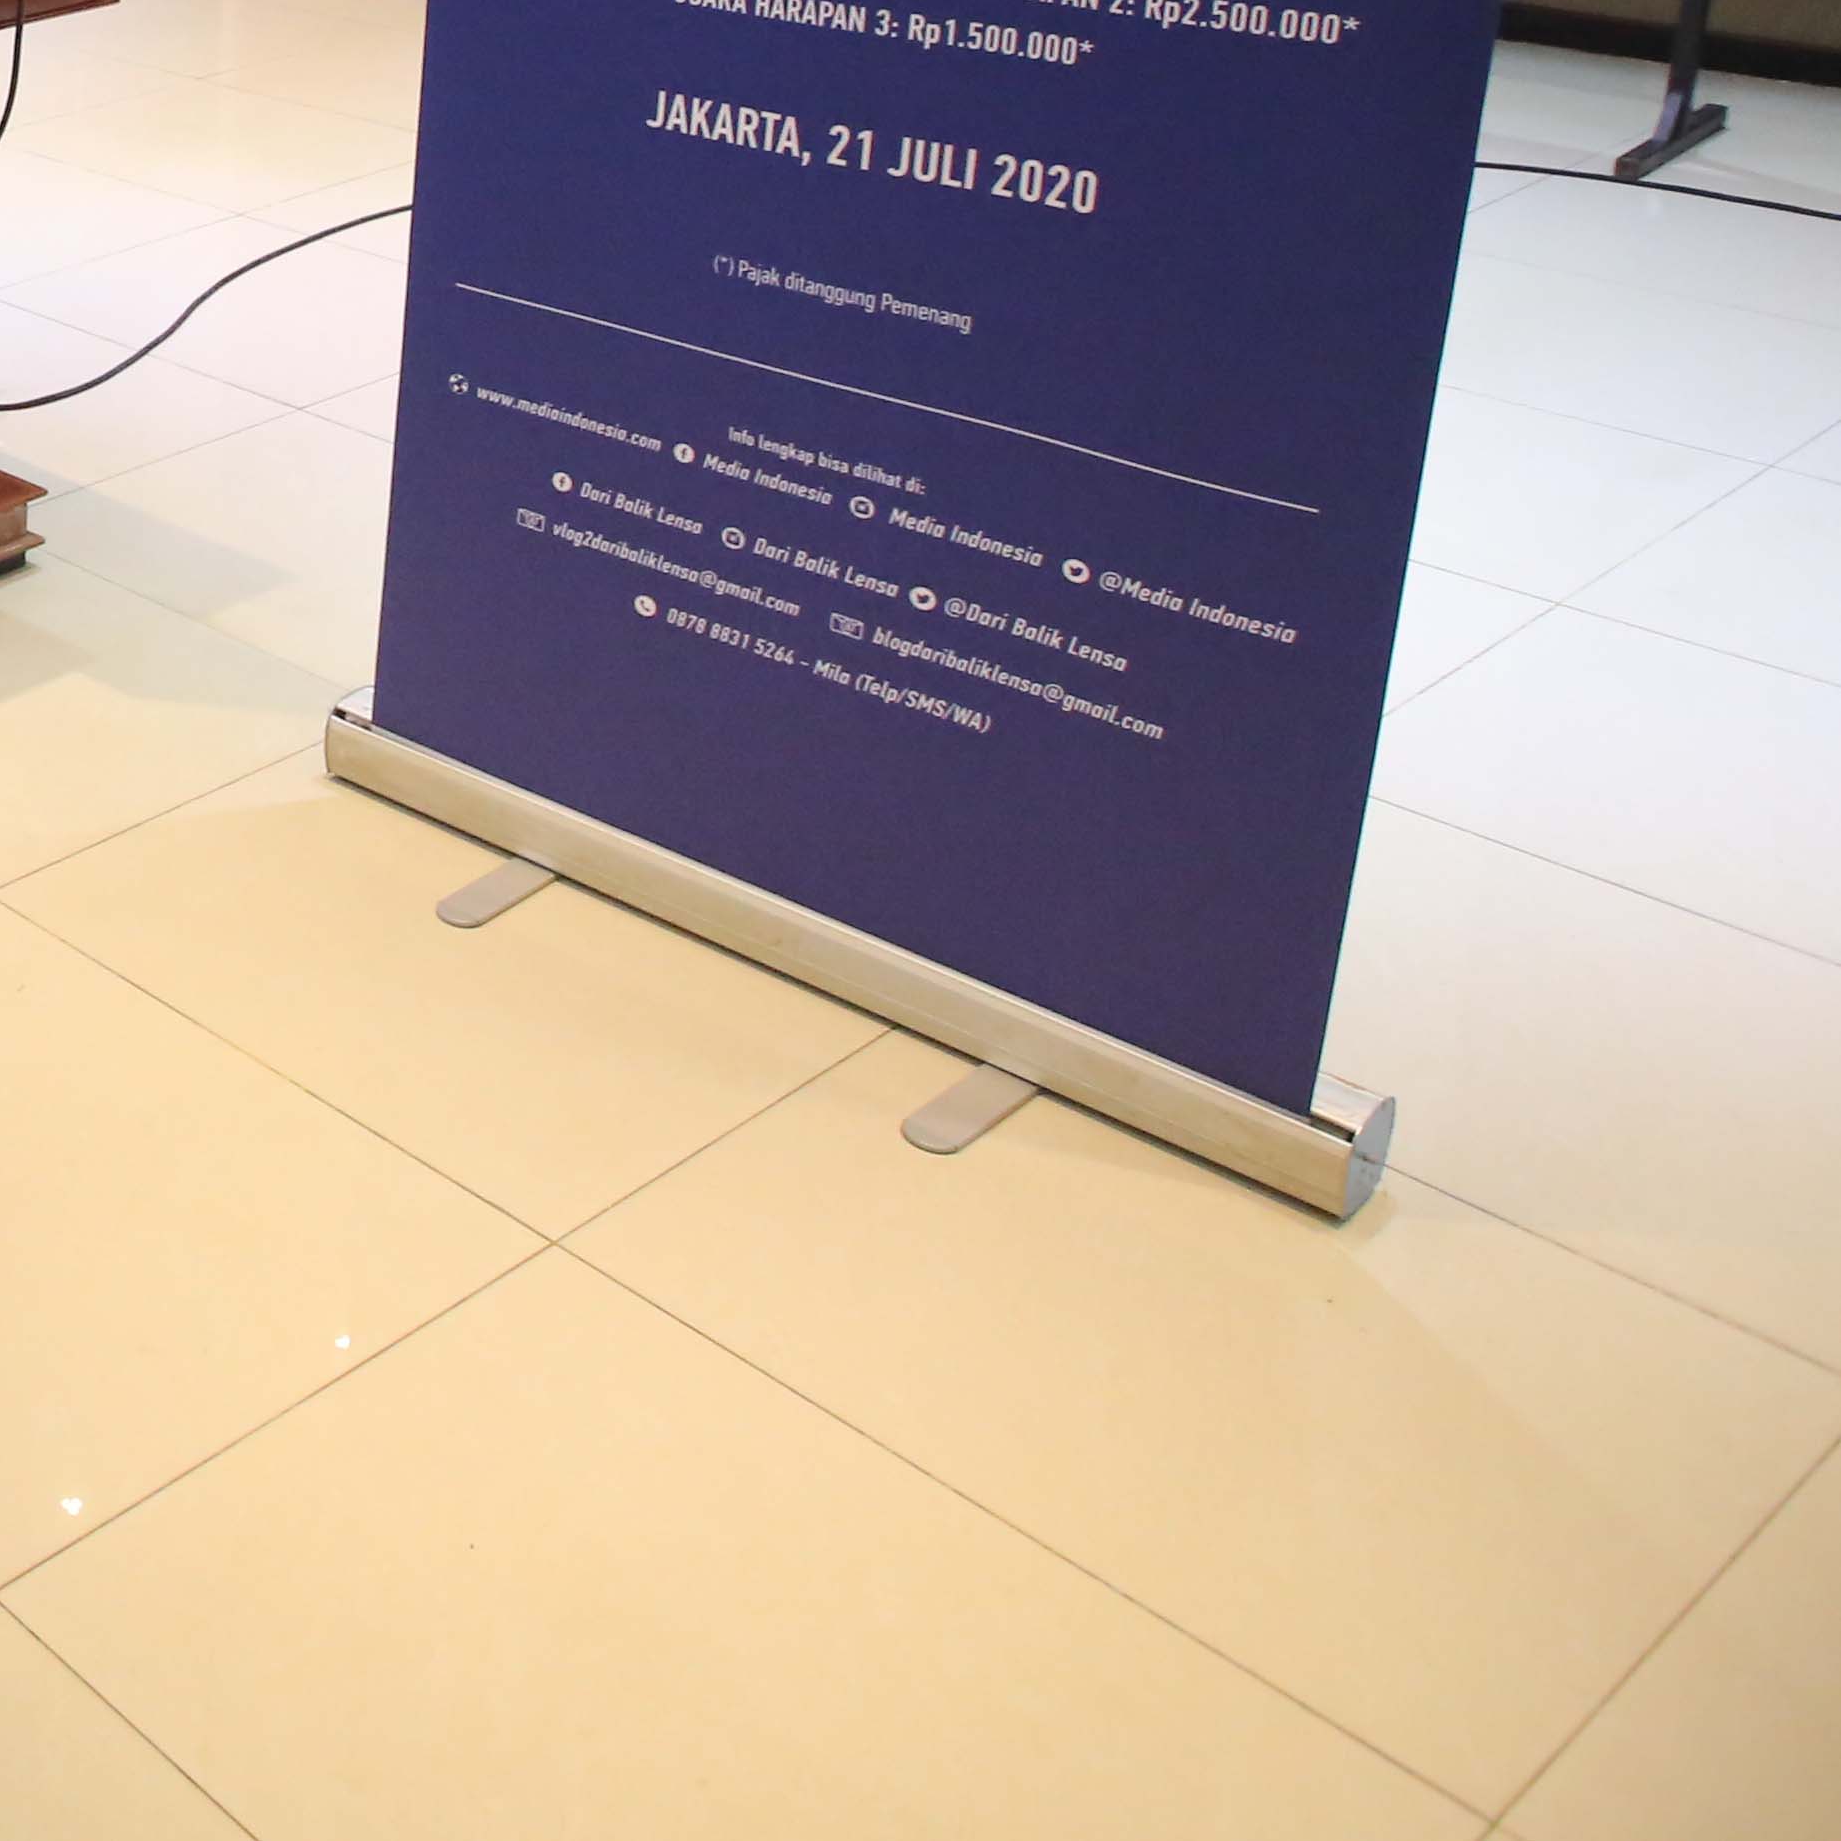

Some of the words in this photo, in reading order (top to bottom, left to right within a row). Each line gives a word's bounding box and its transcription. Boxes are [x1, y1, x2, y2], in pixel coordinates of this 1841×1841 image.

[874, 7, 899, 40] 3:
[646, 89, 812, 167] JAKARTA,
[827, 124, 874, 171] 21
[887, 134, 977, 193] JULI
[991, 153, 1099, 217] 2020
[737, 259, 780, 287] Pajak
[784, 271, 876, 314] ditanggung
[880, 292, 973, 335] Pemenang
[476, 385, 663, 453] www.mediaindonesia.com
[703, 453, 751, 481] Media
[754, 467, 834, 506] Indonesia
[888, 506, 946, 539] Media
[949, 524, 1045, 568] Indonesia
[1098, 570, 1185, 614] @Media
[1188, 597, 1298, 645] Indonesia
[728, 426, 755, 447] Info
[758, 433, 815, 467] lengkap
[817, 450, 849, 475] bisa
[852, 462, 902, 489] dilihat
[552, 520, 802, 618] vlog2daribaliklensa@gmail.com
[872, 625, 1165, 741] blogdaribaliklensa@gmail.com
[579, 481, 612, 505] Dari
[613, 490, 654, 520] Balik
[656, 506, 704, 535] Lensa
[752, 536, 791, 564] Dari
[794, 549, 841, 581] Balik
[844, 564, 901, 599] Lensa
[943, 596, 1010, 632] @Dari
[1011, 617, 1066, 651] Balik
[1068, 635, 1129, 673] Lensa
[666, 607, 708, 635] 0878
[709, 621, 751, 650] 8831
[753, 635, 796, 666] 5264
[813, 658, 851, 686] Mila
[854, 671, 993, 736] (Telp/SMS/WA)
